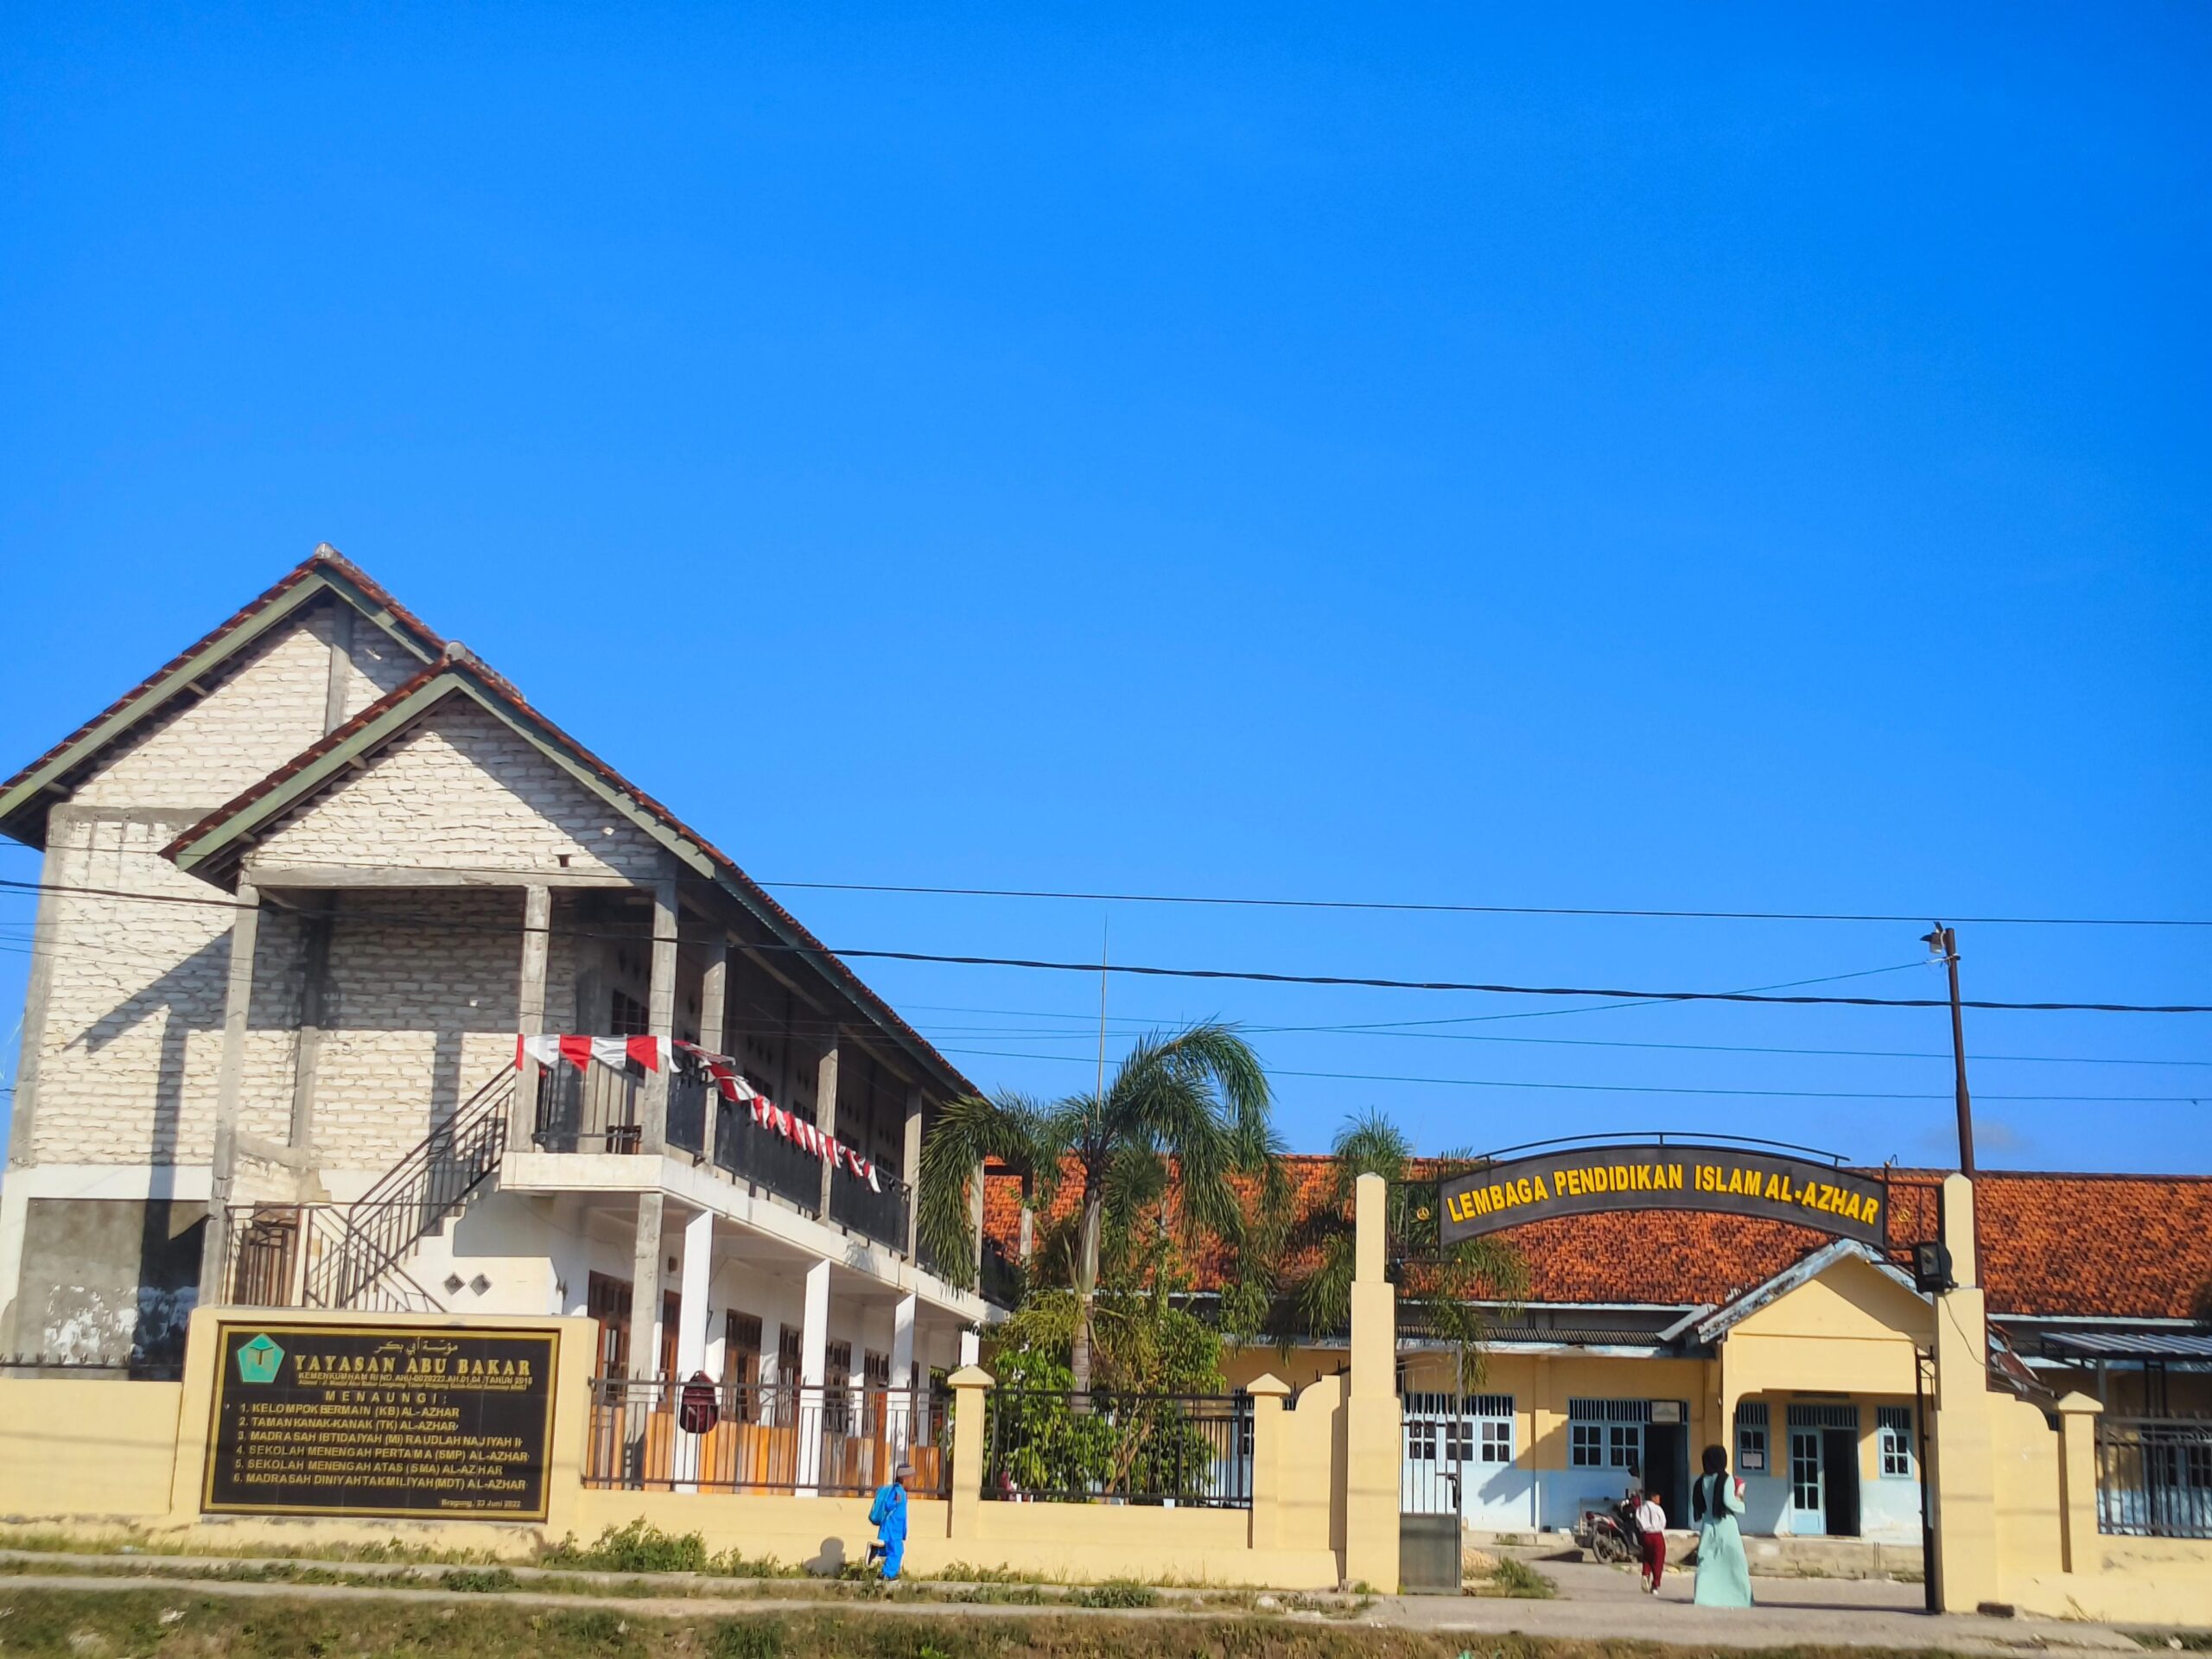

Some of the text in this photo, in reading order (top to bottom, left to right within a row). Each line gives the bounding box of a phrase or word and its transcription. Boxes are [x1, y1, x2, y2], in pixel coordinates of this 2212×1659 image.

[1447, 1164, 1878, 1224] LEMBAGA PENDIDIKAN ISLAM AL-AZHAR
[295, 1355, 530, 1375] YAYASAN ABU BAKAR
[240, 1403, 249, 1413] 1.
[252, 1403, 318, 1414] KELOMPOK
[321, 1405, 371, 1415] BERMAIN
[375, 1406, 400, 1417] (KB)
[238, 1417, 457, 1432] 2. TAMAN KANAK-KANAK (TK) AL-AZHAR
[238, 1431, 246, 1440] 3.
[251, 1431, 316, 1442] MADRASAH
[319, 1433, 382, 1443] IBTIDAIYAH
[385, 1434, 404, 1446] (MI)
[406, 1434, 461, 1446] RAUDLAH
[463, 1436, 512, 1447] NAJIYAH
[236, 1445, 528, 1462] 4. SEKOLAH MENENGAH PERTAMA (SMP) AL-AZHAR
[235, 1459, 503, 1475] 5. SEKOLAH MENENGAH ATAS (SMA) AL-AZHAR
[233, 1473, 525, 1491] 6. MADRASAH DINIYAH TAKMILIYAH (MDT) AL-AZHAR
